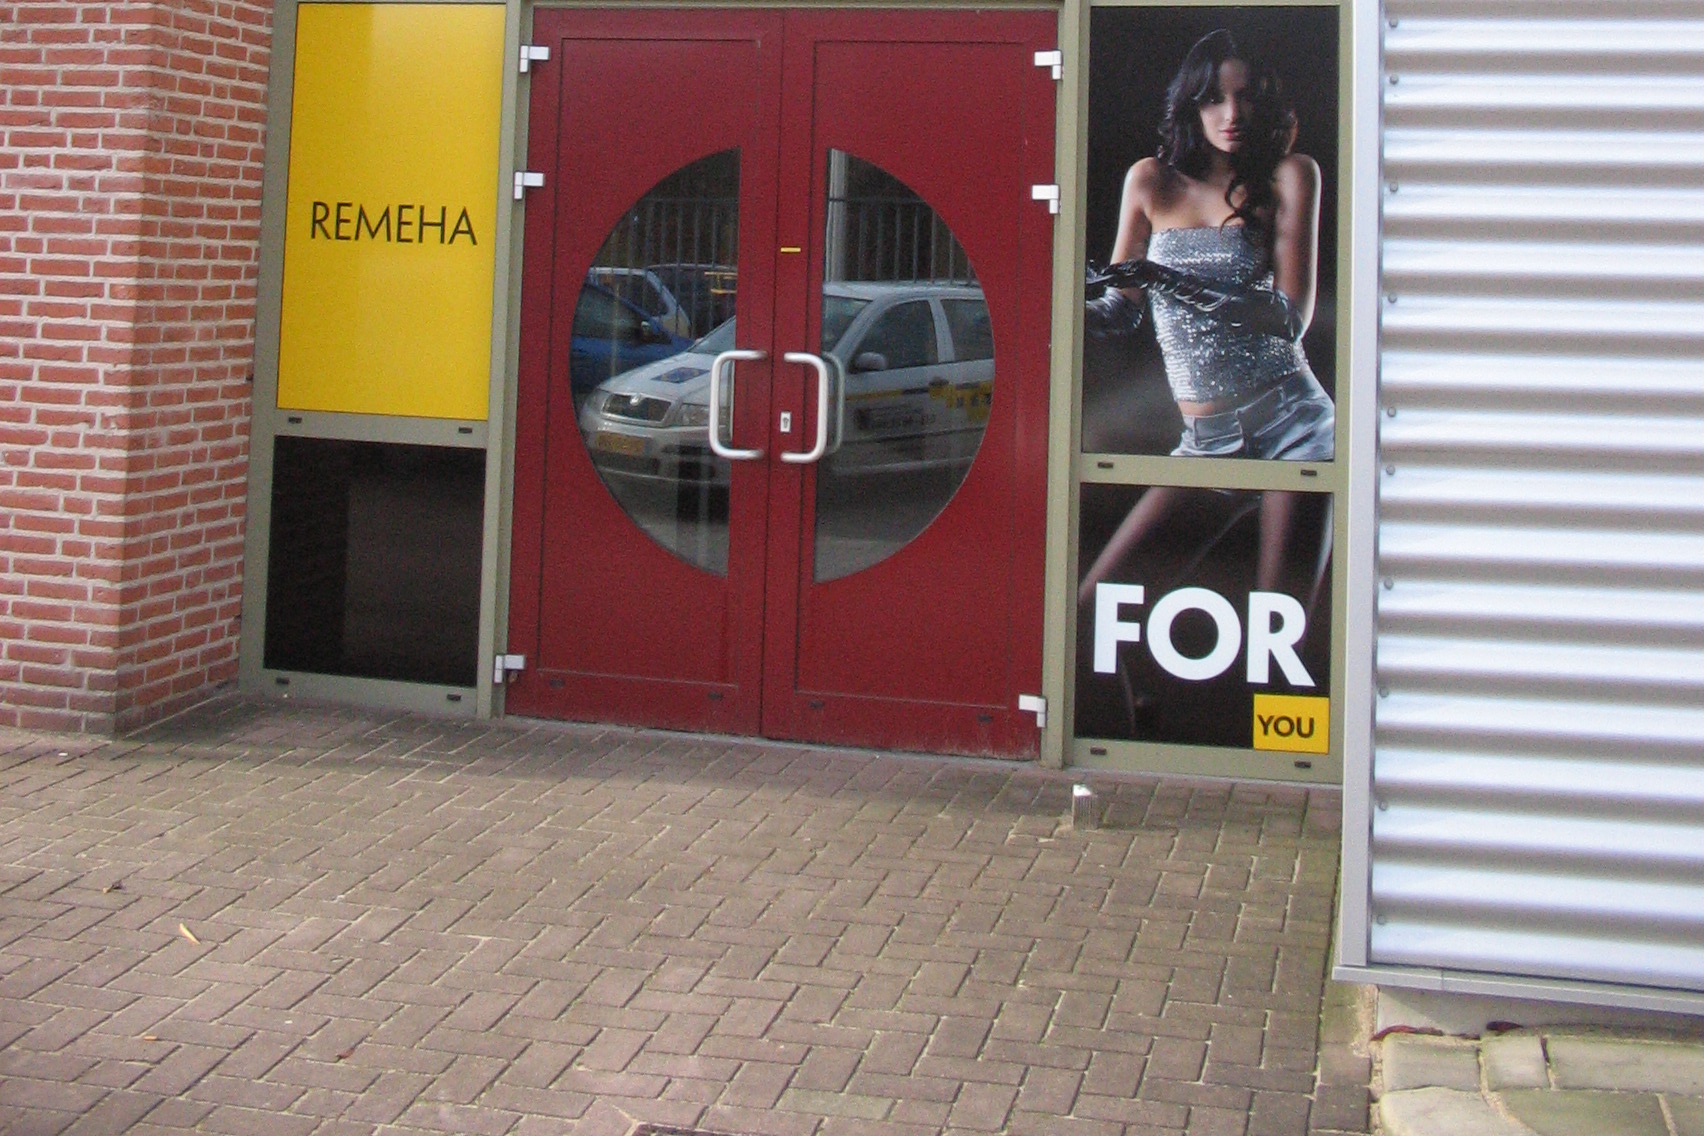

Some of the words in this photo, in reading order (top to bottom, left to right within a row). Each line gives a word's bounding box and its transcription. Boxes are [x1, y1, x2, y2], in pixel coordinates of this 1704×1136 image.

[311, 201, 478, 246] REMEHA
[1093, 582, 1316, 688] FOR
[1257, 714, 1315, 740] YOU
